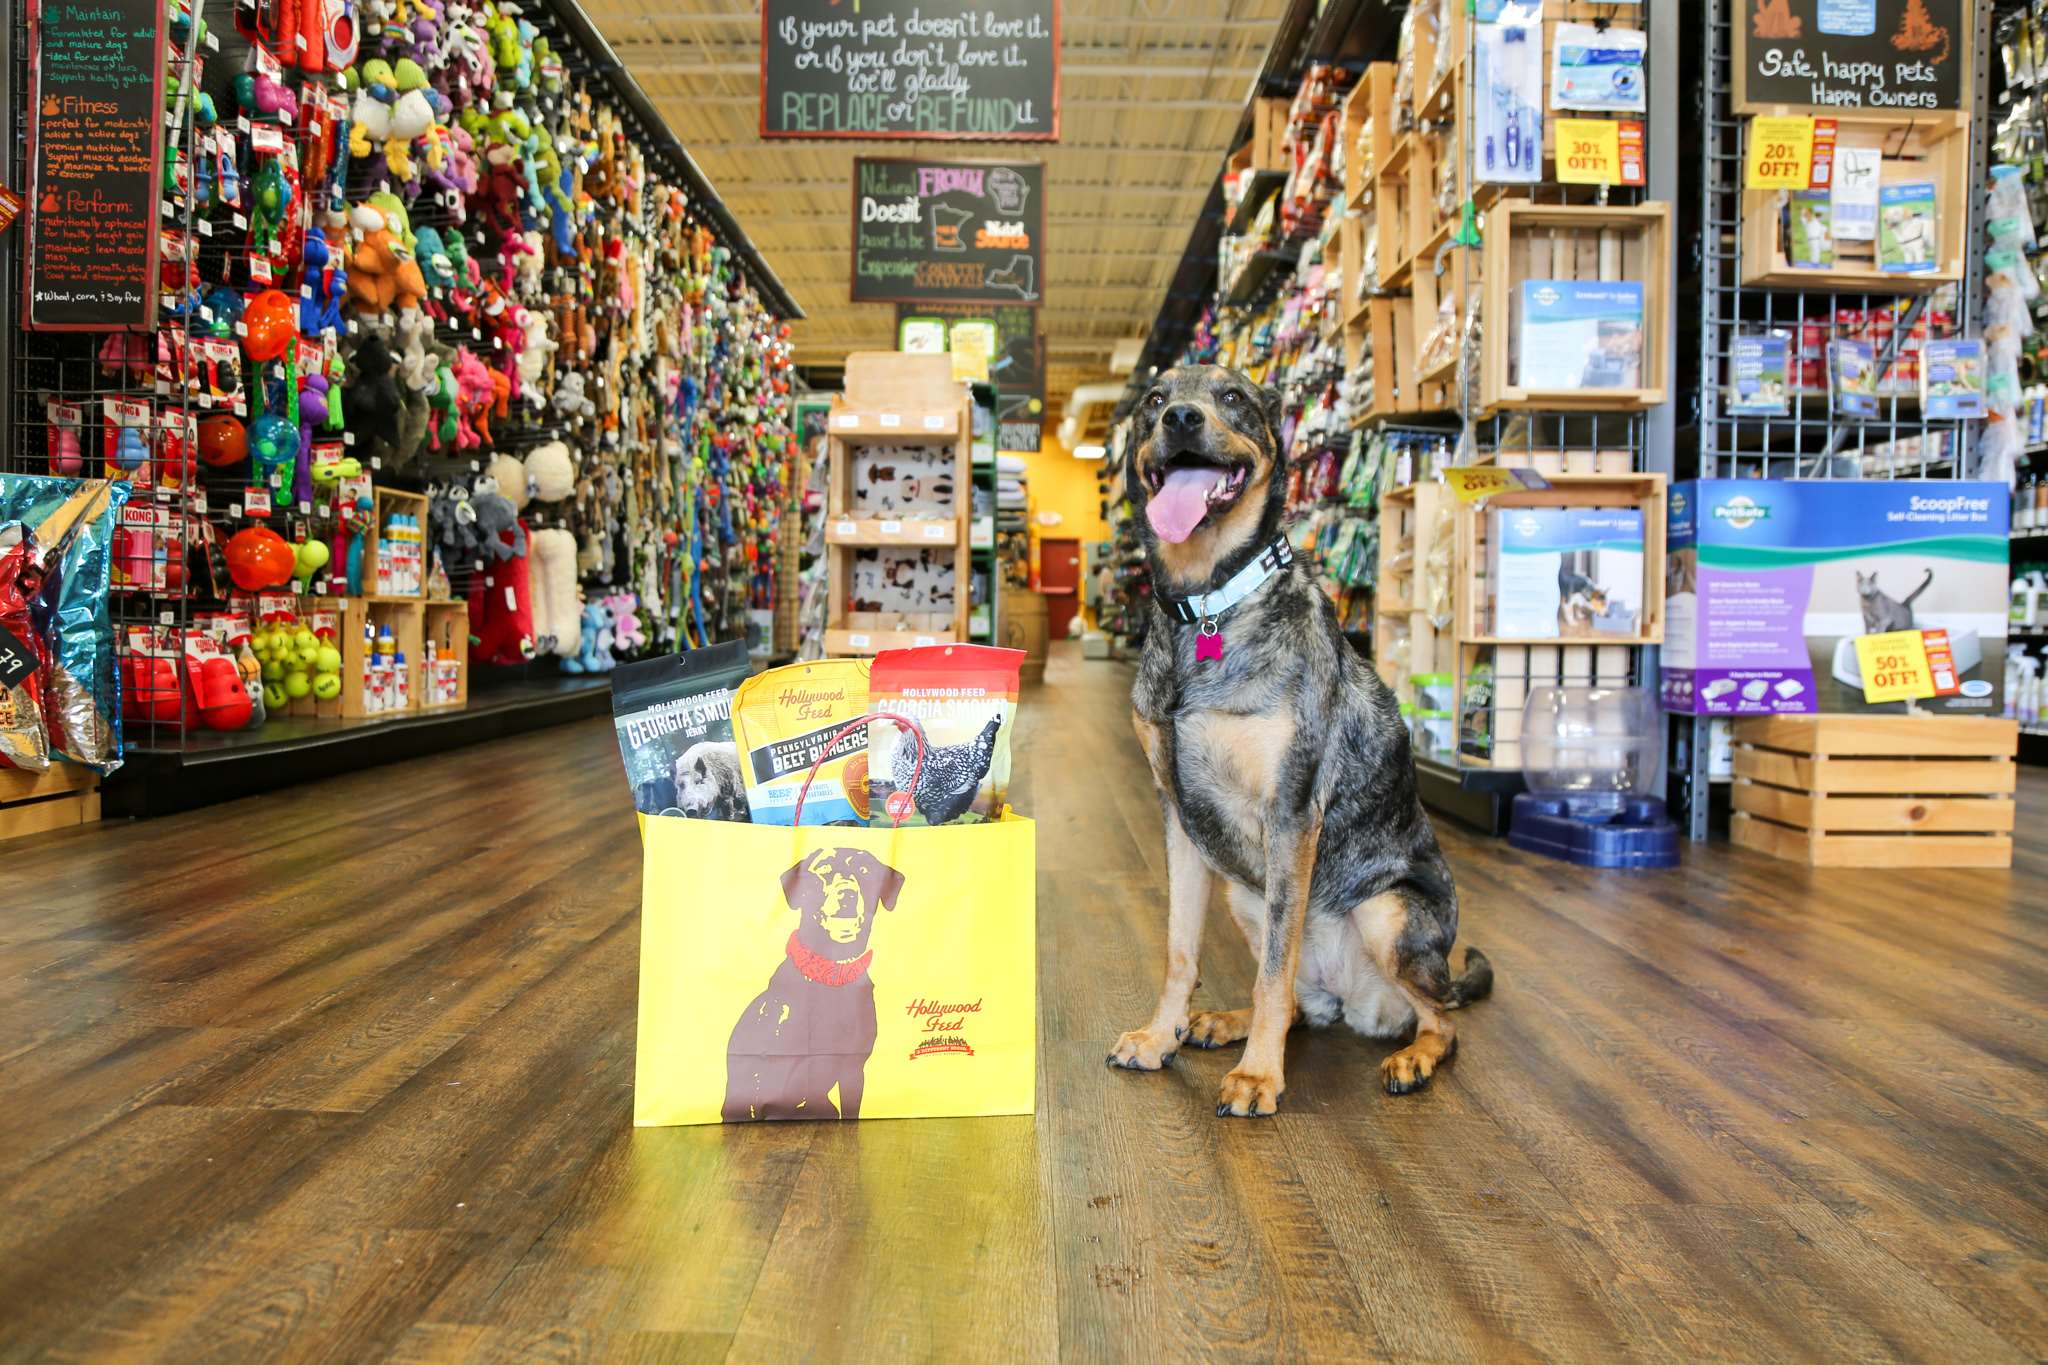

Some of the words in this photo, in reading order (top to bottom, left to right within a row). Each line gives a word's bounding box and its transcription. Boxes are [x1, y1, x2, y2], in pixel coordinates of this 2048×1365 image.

[110, 26, 127, 38] for
[801, 19, 858, 49] your
[863, 13, 898, 45] pet
[904, 8, 980, 38] doesn't
[984, 11, 1023, 37] love
[47, 40, 64, 48] and
[69, 40, 102, 48] mature
[105, 40, 128, 55] dogs
[74, 51, 90, 61] for
[93, 52, 124, 68] weight
[795, 50, 822, 69] or
[825, 44, 843, 73] if
[846, 48, 888, 75] you
[892, 38, 947, 67] don't
[957, 40, 999, 67] love
[1758, 48, 1818, 78] Safe,
[1822, 50, 1884, 90] happy
[848, 68, 898, 93] we'll
[903, 64, 971, 102] gladly
[1811, 81, 1861, 107] Happy
[1869, 88, 1938, 108] Owners
[63, 95, 119, 114] Fitness
[782, 91, 889, 131] REPLACE
[886, 101, 914, 124] or
[915, 97, 1018, 132] REFUND
[85, 117, 99, 128] for
[75, 131, 84, 139] to
[88, 131, 116, 139] active
[120, 131, 139, 144] dogs
[86, 144, 126, 153] nutrition
[131, 143, 142, 153] to
[1765, 144, 1795, 159] 20%
[47, 153, 79, 163] support
[83, 154, 114, 162] muscle
[1567, 156, 1608, 171] OFF!
[1759, 161, 1800, 177] OFF!
[67, 188, 133, 213] Perform:
[860, 223, 890, 249] have
[892, 220, 906, 249] to
[909, 223, 925, 249] be
[125, 290, 142, 303] free
[115, 402, 135, 416] KONG
[1909, 496, 1989, 512] ScoopFree
[125, 509, 152, 522] KONG
[1887, 512, 1945, 523] Self-Cleaning
[1875, 655, 1910, 671] 50%
[1873, 670, 1919, 688] OFF!
[647, 694, 704, 714] HOLLYWOOD
[705, 687, 729, 700] FEED
[778, 688, 844, 708] Hollywood
[903, 688, 960, 697] HOLLYWOOD
[961, 688, 986, 697] FEED
[878, 698, 942, 719] GEORGIA
[626, 709, 693, 750] GEORGIA
[685, 724, 708, 738] JERKY
[770, 729, 838, 758] PENNSYLVANIA
[772, 749, 807, 775] BEEF
[905, 998, 982, 1018] Hollywood
[921, 1015, 964, 1032] Feed
